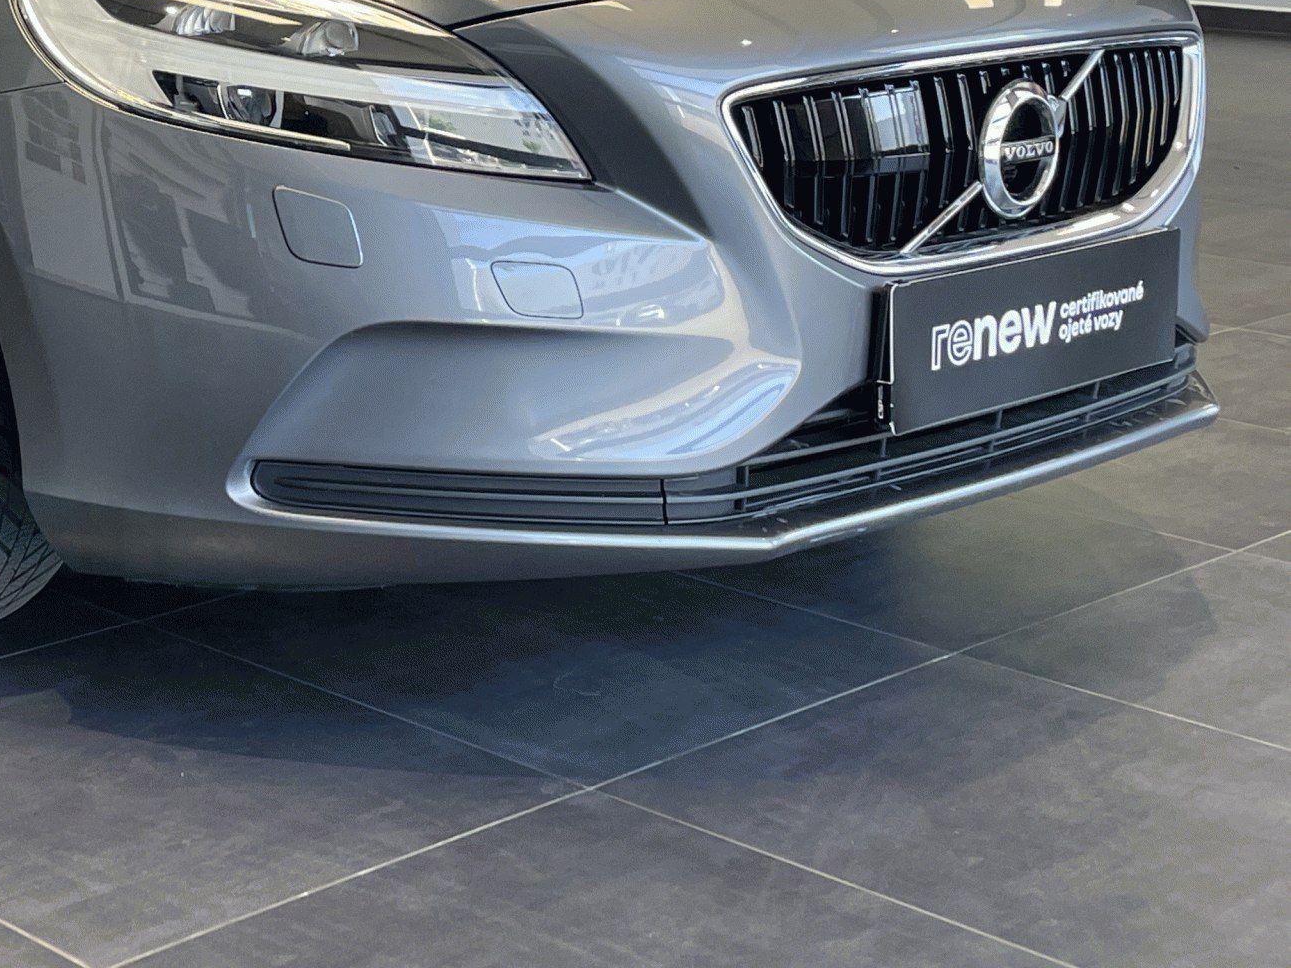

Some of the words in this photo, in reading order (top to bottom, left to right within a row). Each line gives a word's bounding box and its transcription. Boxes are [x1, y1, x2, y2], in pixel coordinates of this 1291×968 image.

[1004, 140, 1054, 160] VOLVO
[1060, 280, 1144, 318] certifikované
[931, 300, 1057, 371] renew
[1058, 312, 1092, 343] ojeté
[1093, 309, 1123, 331] vozy
